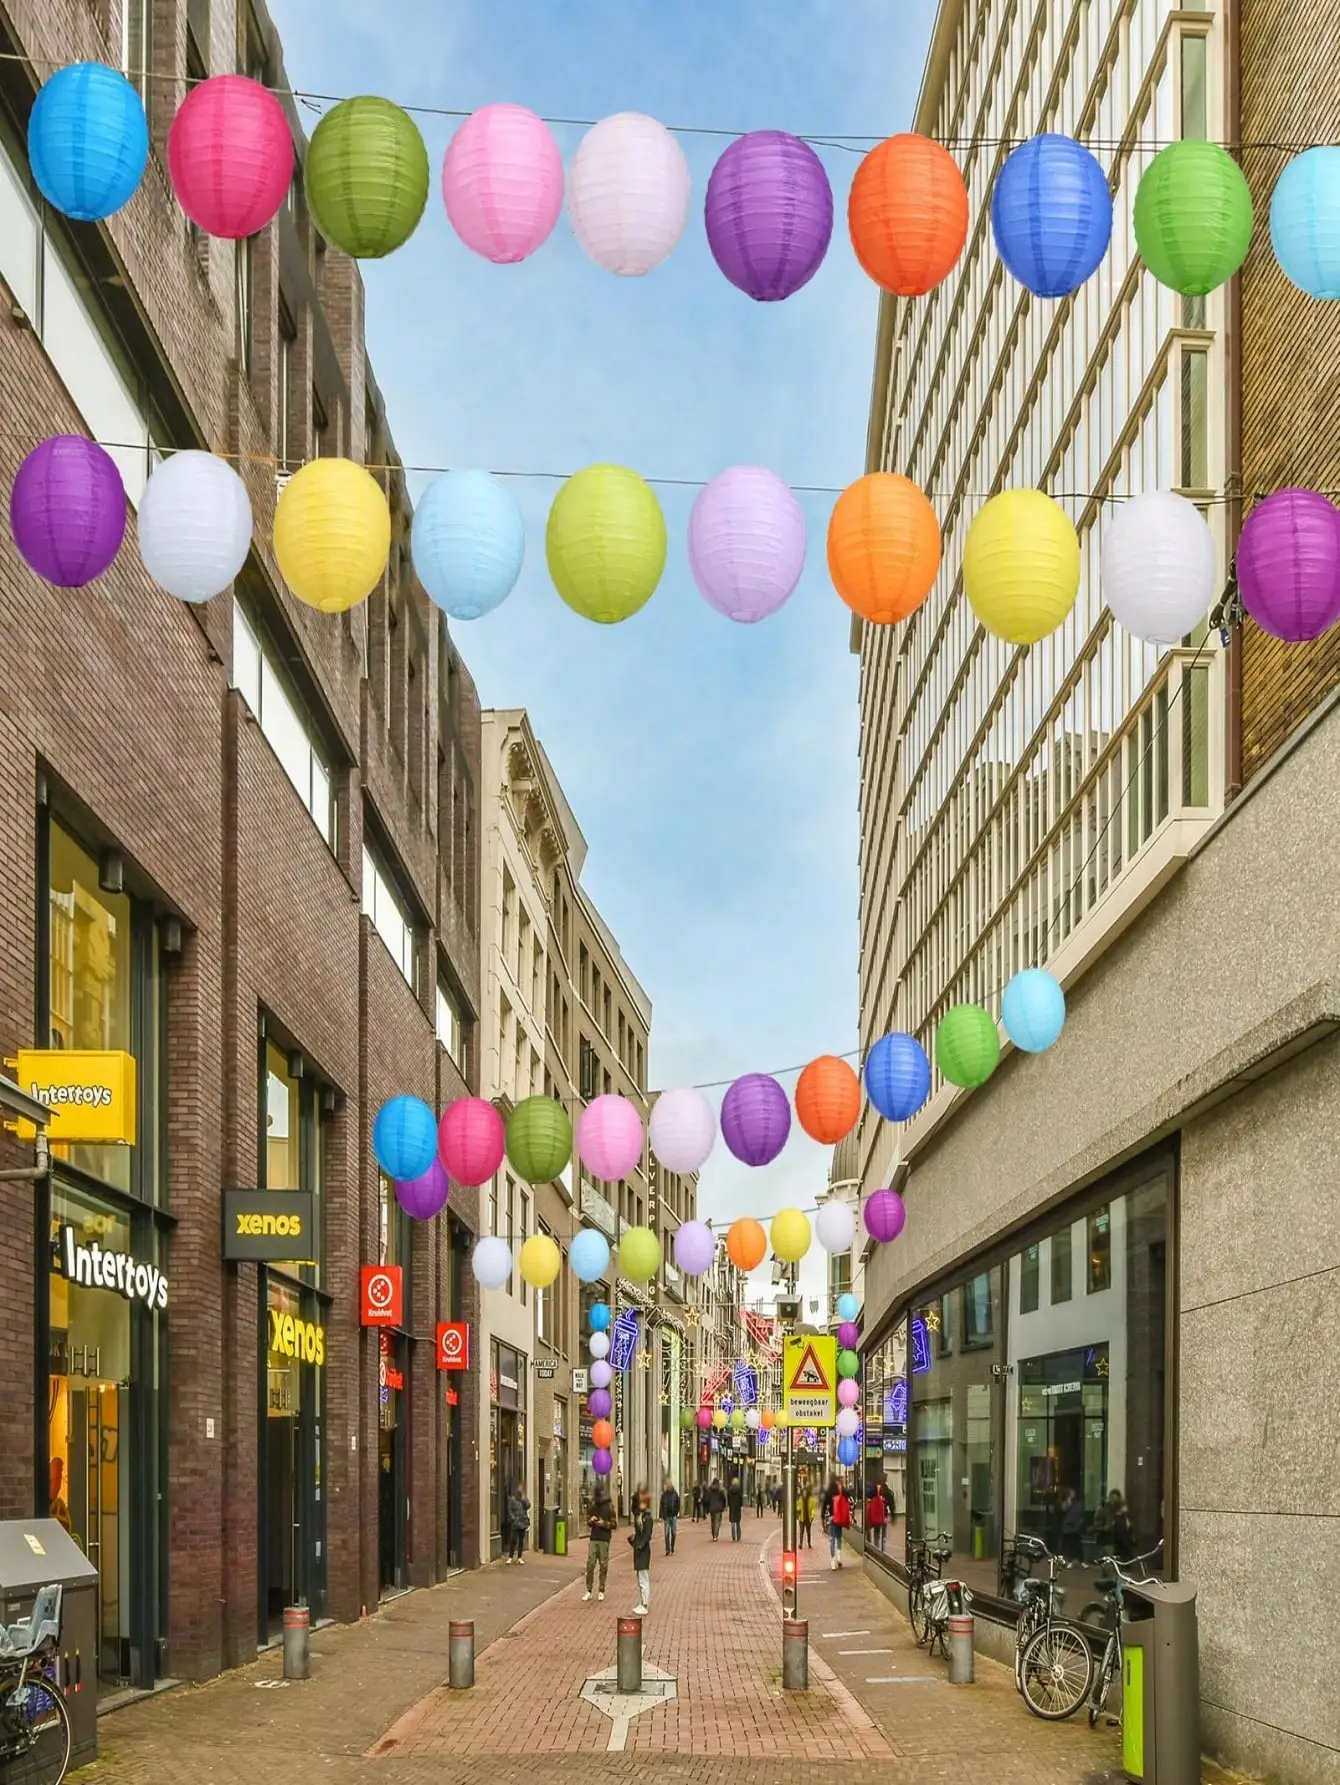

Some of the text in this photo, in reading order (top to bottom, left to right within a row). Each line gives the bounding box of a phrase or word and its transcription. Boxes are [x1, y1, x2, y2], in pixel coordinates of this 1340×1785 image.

[31, 1083, 112, 1107] Intertoys
[236, 1214, 301, 1236] xenos
[64, 1226, 168, 1309] Intertoys
[271, 1309, 324, 1366] xenos
[790, 1398, 829, 1407] beweegbaar
